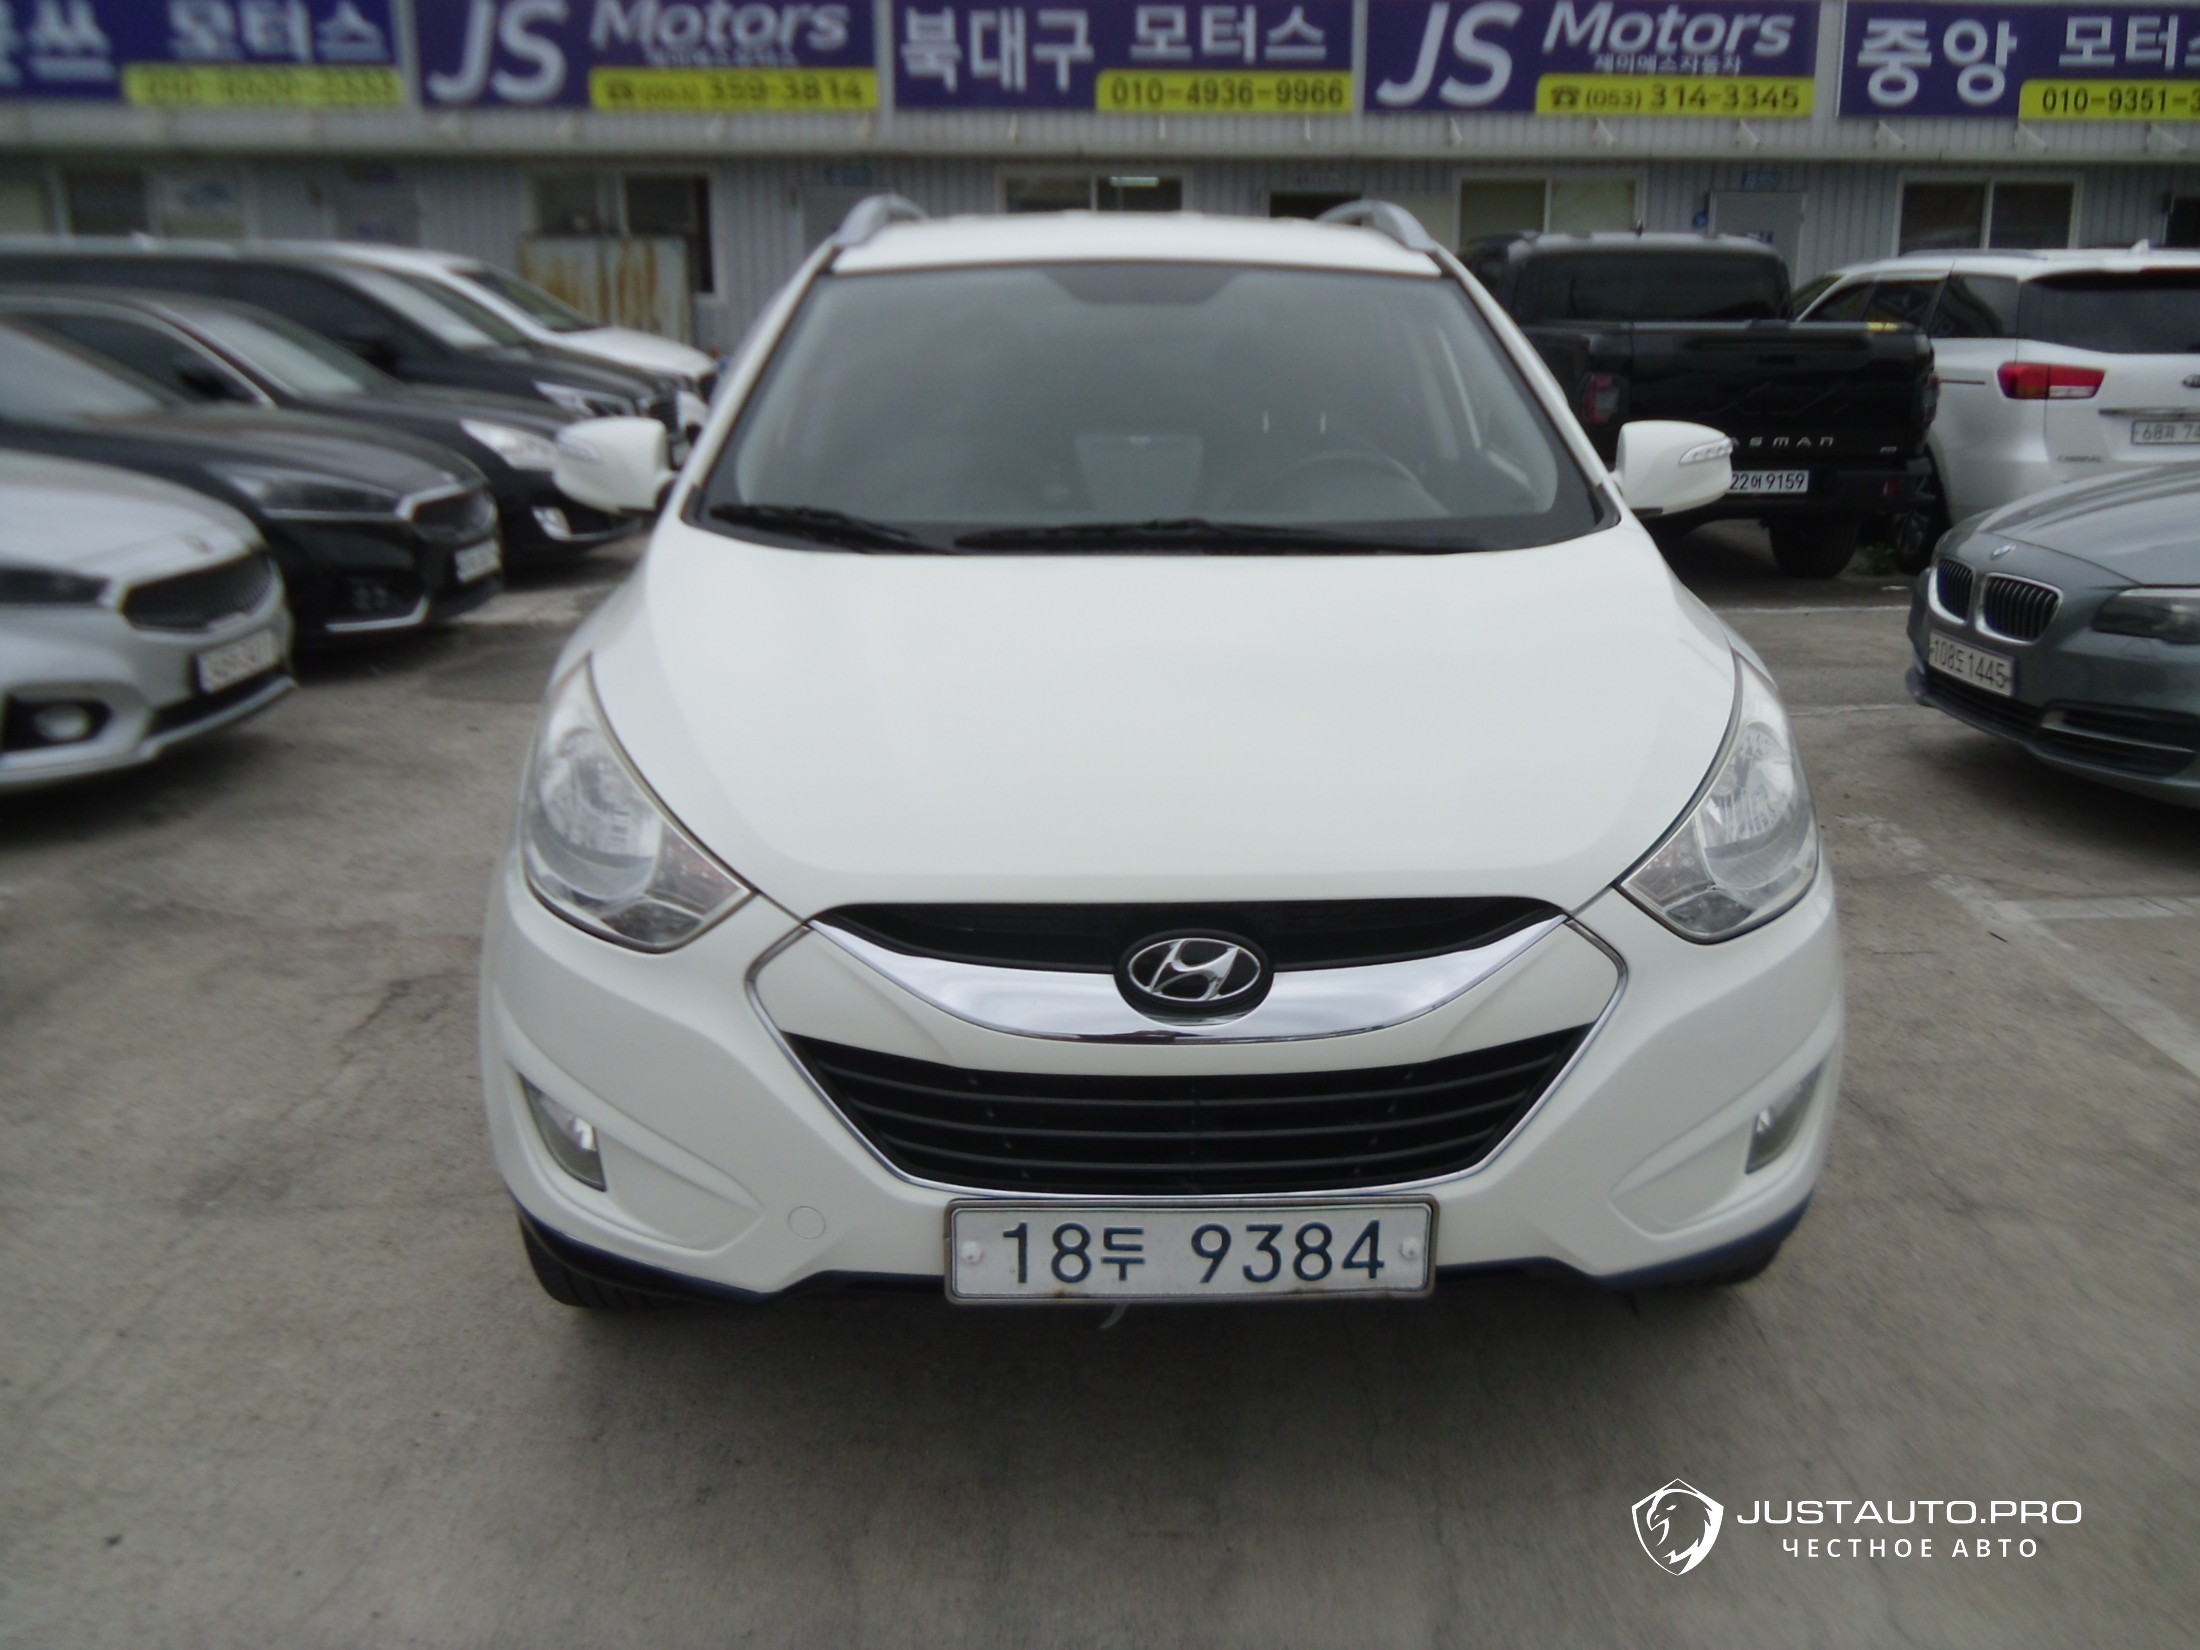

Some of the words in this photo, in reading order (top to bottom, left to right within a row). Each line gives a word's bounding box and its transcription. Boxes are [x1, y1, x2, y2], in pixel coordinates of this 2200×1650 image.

[427, 0, 568, 104] JS
[588, 0, 850, 51] Motors
[901, 7, 1095, 93] 북대구
[1130, 5, 1328, 64] 모터스
[1375, 0, 1523, 106] JS
[1541, 3, 1796, 56] Motors
[1857, 18, 2018, 107] 중앙
[2059, 14, 2200, 72] 모터
[1111, 76, 1345, 105] 010-4936-9966
[1586, 86, 1641, 110] (053)
[1650, 82, 1800, 109] 314-3345
[1766, 472, 1806, 490] 9159
[1968, 652, 2006, 688] 1445
[1003, 1221, 1145, 1285] 18두
[1190, 1218, 1385, 1285] 9384
